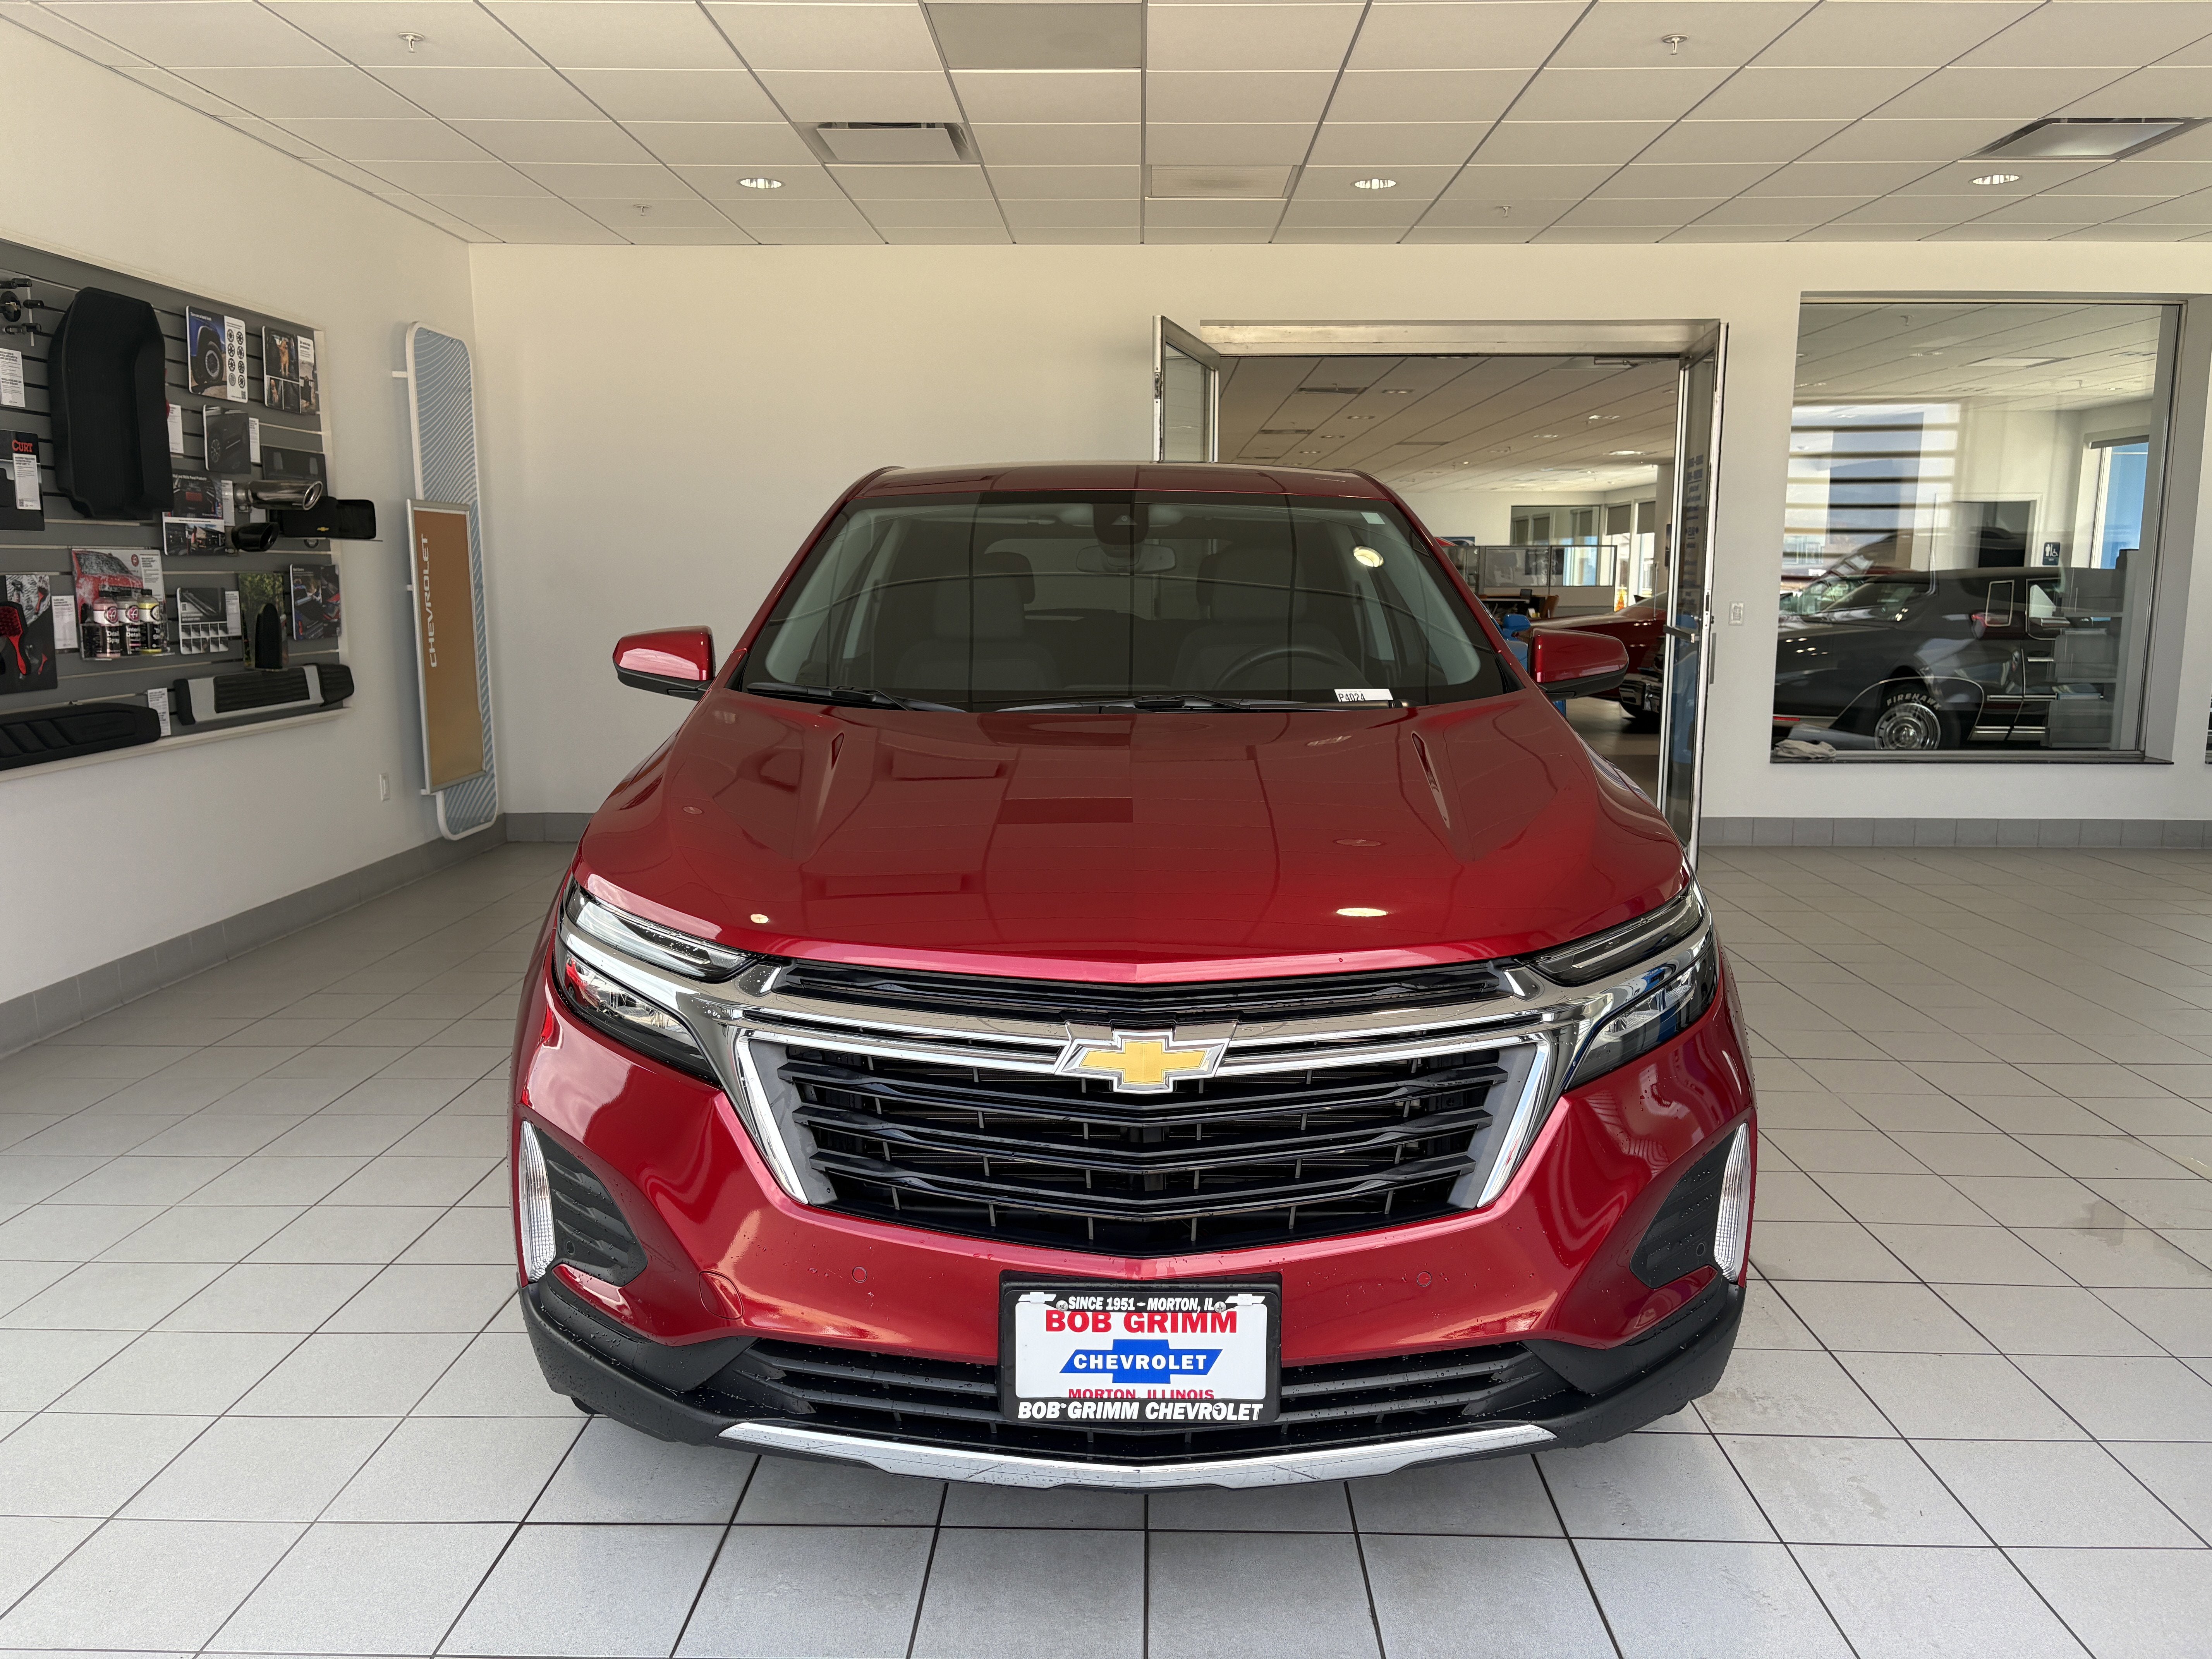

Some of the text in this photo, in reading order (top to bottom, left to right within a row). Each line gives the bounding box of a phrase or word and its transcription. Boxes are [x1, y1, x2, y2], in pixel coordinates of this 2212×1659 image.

[12, 440, 33, 452] CURT
[421, 533, 437, 667] CHEVROLET
[1887, 693, 1942, 710] FIREHAWK
[1068, 1296, 1103, 1310] SINCE
[1106, 1297, 1135, 1310] 1951
[1147, 1298, 1200, 1313] MORTON,
[1204, 1298, 1214, 1311] IL
[1046, 1310, 1237, 1333] BOB GRIMM
[1074, 1354, 1207, 1370] CHEVROLET
[1018, 1402, 1263, 1421] BOB GRIMM CHEVROLET
